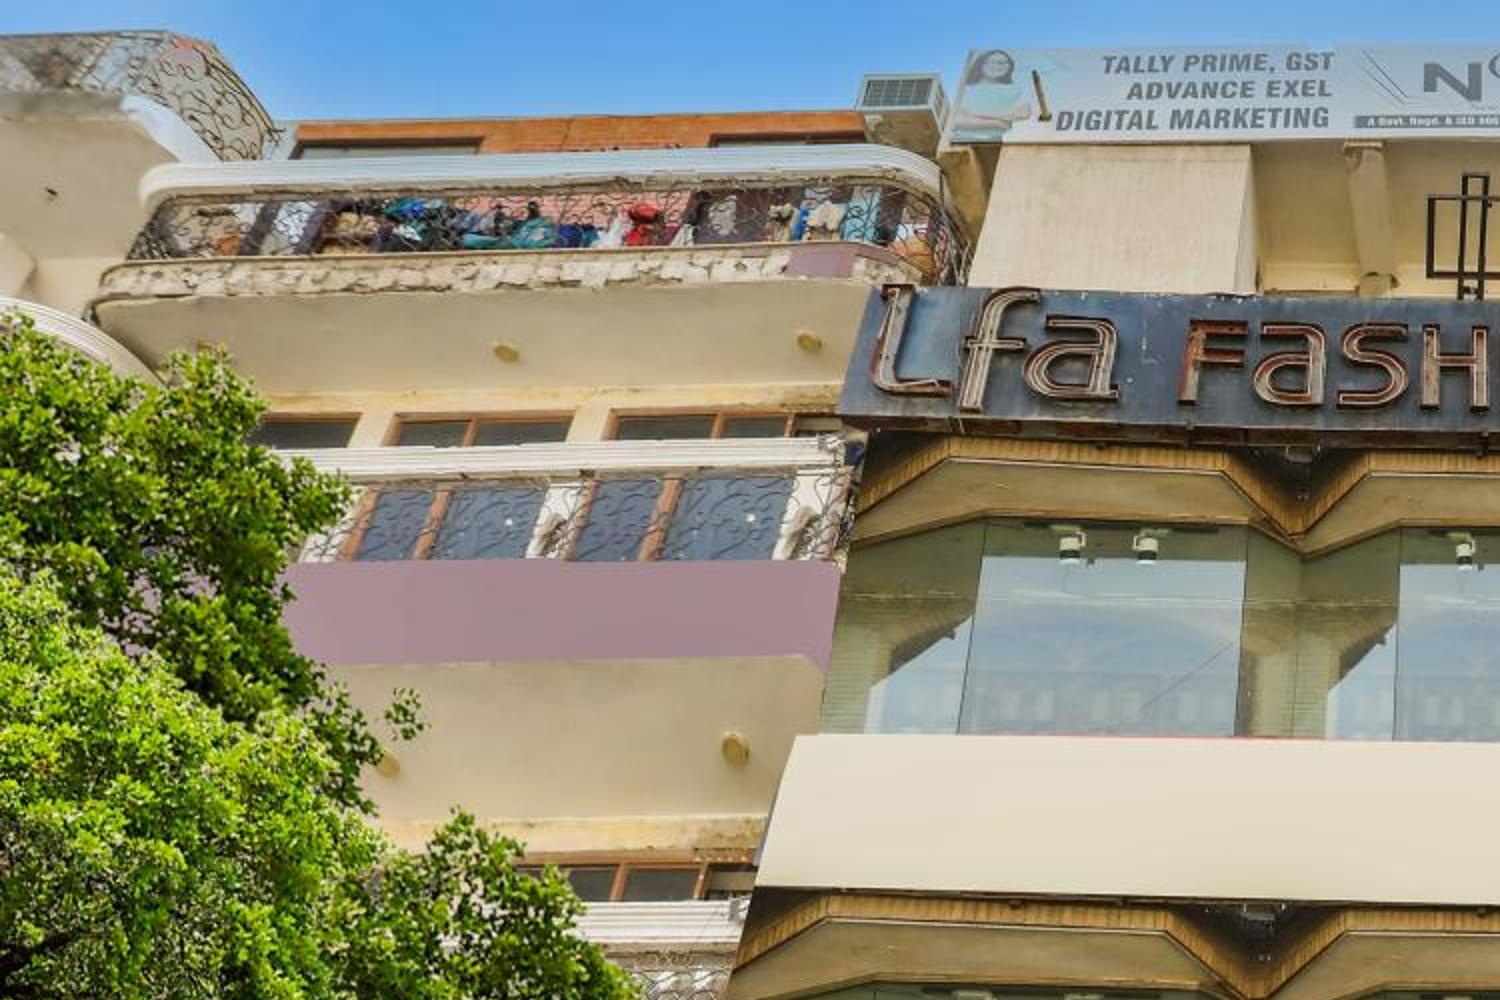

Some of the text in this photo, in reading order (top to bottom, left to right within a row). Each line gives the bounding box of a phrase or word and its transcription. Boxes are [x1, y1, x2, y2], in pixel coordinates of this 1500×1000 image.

[1103, 52, 1334, 74] TALLY PRIME, GST
[1126, 79, 1332, 99] ADVANCE EXEL
[1056, 107, 1329, 131] DIGITAL MARKETING
